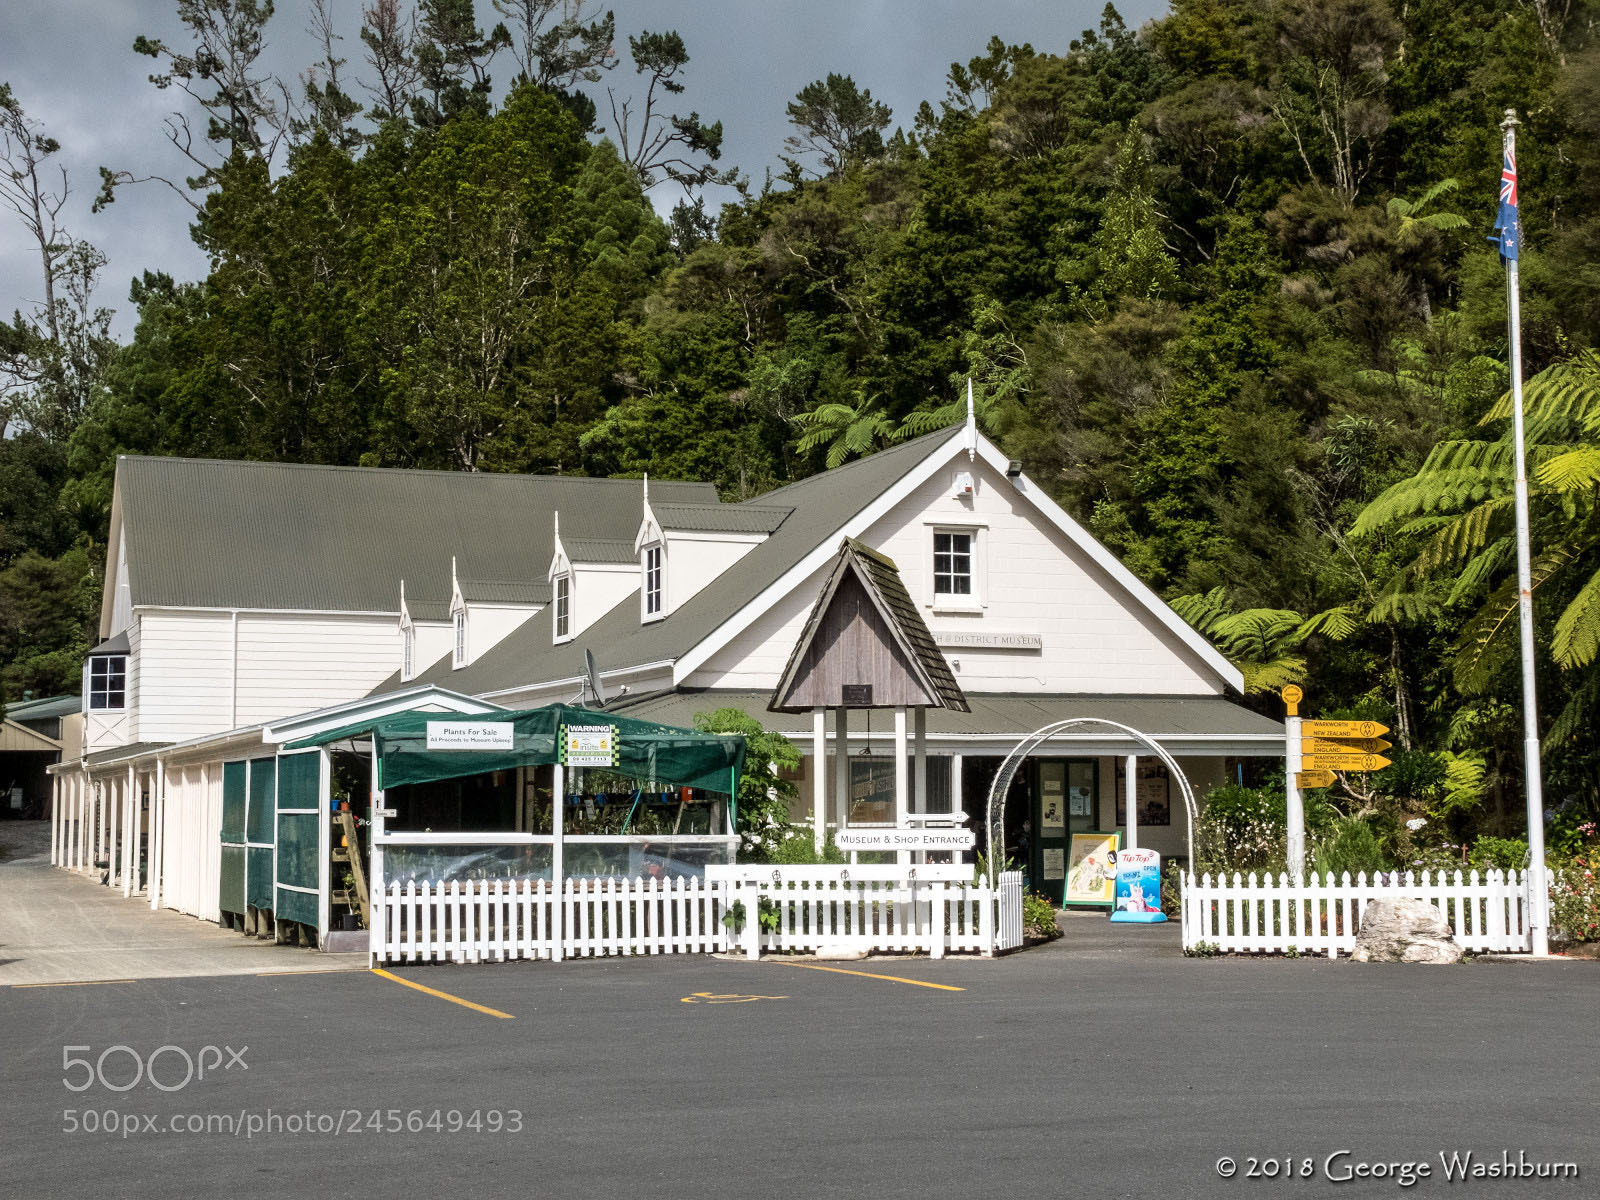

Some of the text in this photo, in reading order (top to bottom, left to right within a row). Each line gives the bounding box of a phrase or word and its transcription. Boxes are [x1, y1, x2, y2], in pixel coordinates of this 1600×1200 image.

[954, 635, 998, 644] DISTRICT
[1001, 636, 1041, 645] MUSEUM
[443, 728, 498, 736] Plants For Sale
[840, 835, 970, 844] MUSEUM & SHOP ENTRANCE
